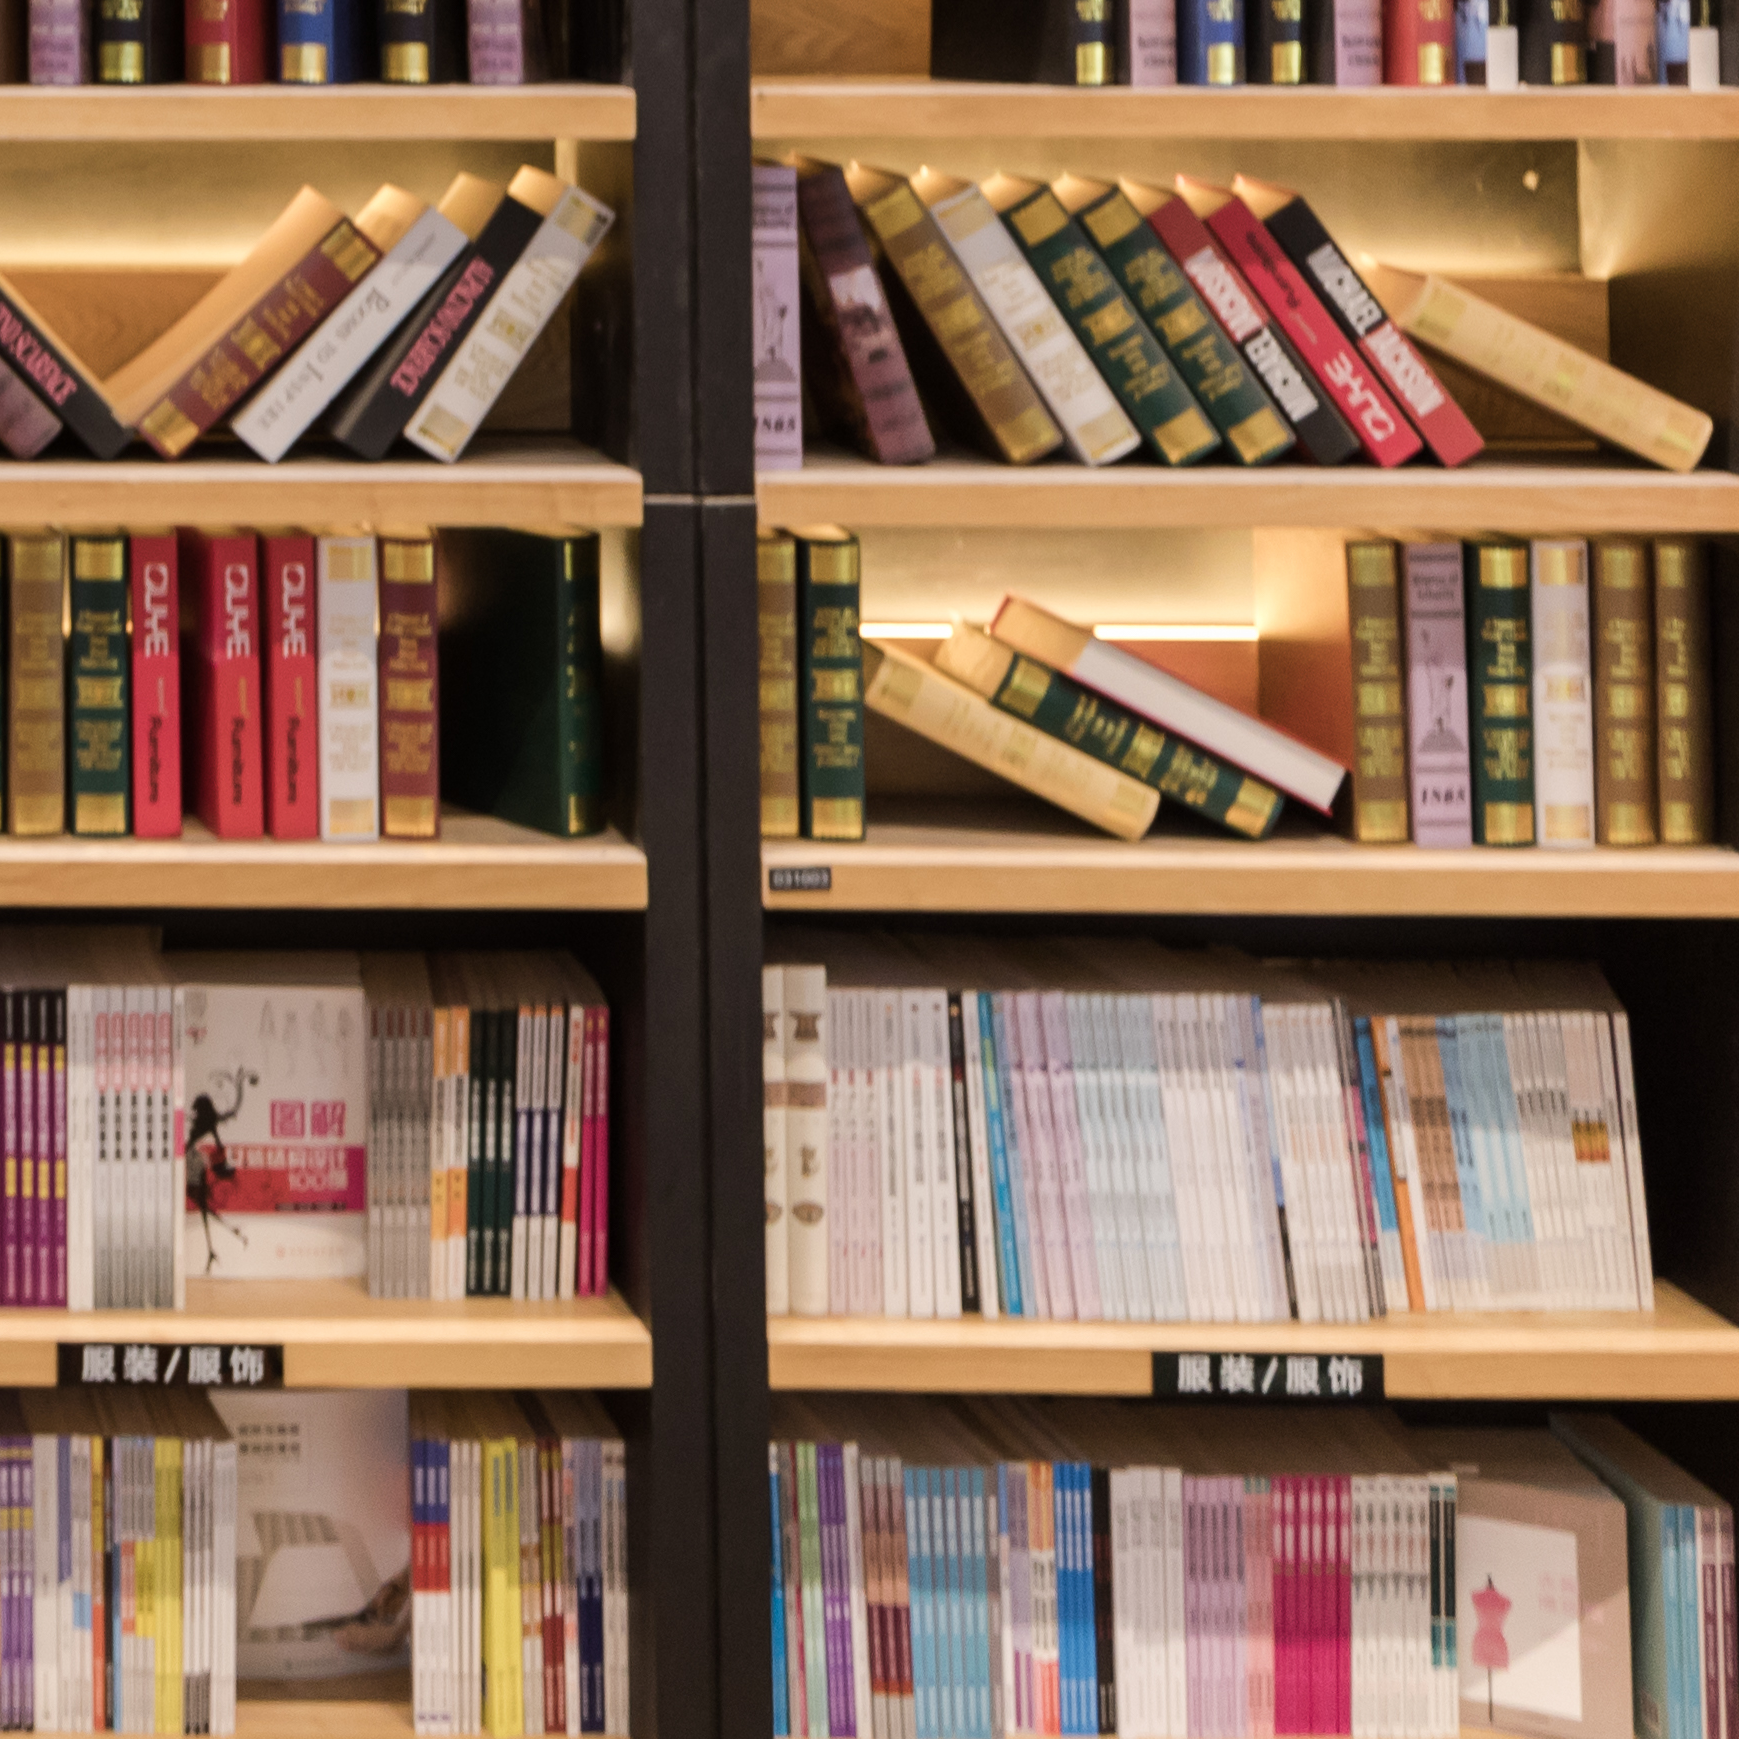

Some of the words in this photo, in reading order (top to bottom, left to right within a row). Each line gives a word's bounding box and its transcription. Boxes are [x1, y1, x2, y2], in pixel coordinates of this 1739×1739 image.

[1181, 244, 1264, 343] JACKSON
[1302, 242, 1386, 337] MICHAEL
[1362, 321, 1446, 416] JACKSON
[1238, 325, 1322, 424] MICHAEL
[81, 1344, 264, 1384] 服装/服饰
[1177, 1353, 1362, 1396] 服装/服饰
